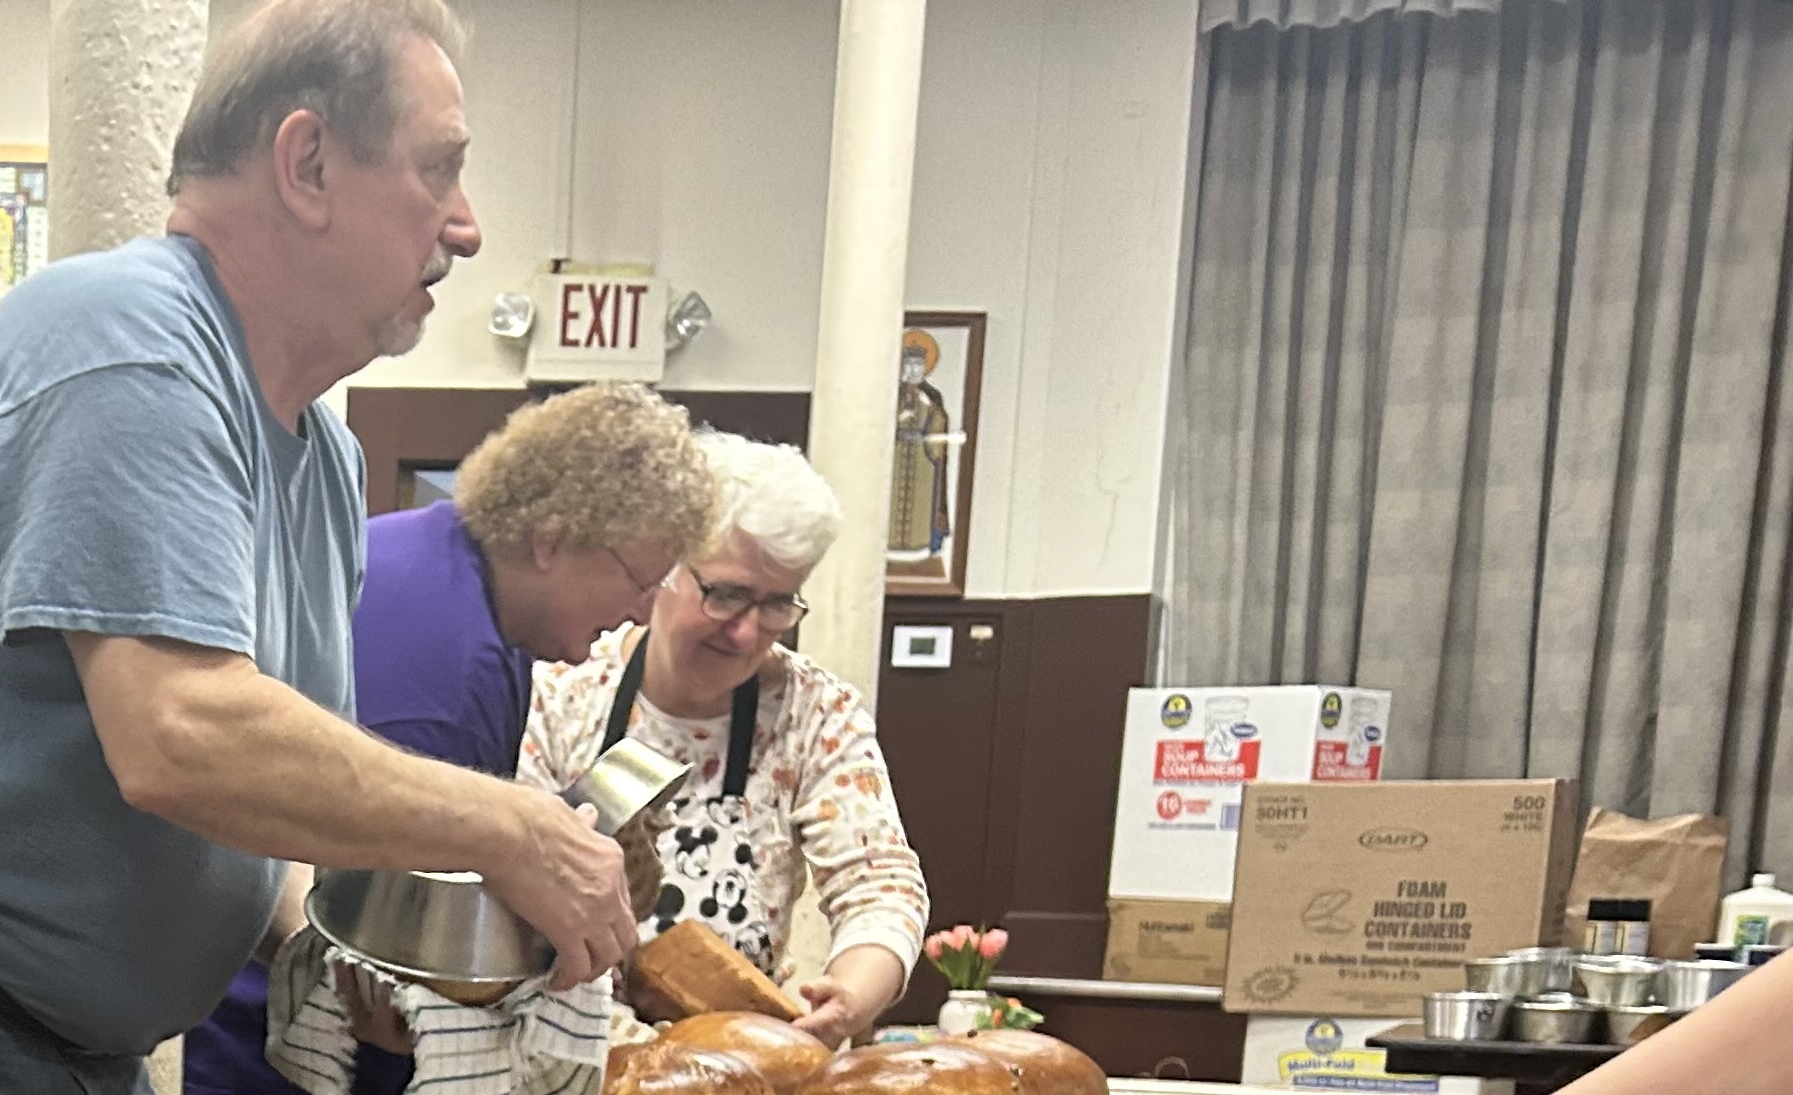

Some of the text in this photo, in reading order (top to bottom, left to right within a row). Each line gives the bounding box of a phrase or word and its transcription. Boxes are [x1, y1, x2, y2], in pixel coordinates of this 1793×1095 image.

[560, 284, 648, 348] EXIT
[1160, 761, 1246, 778] CONTAINERS
[1513, 796, 1546, 810] 500
[1397, 880, 1447, 898] FOAM
[1373, 901, 1467, 919] HINGED LID
[1364, 921, 1472, 939] CONTAINERS
